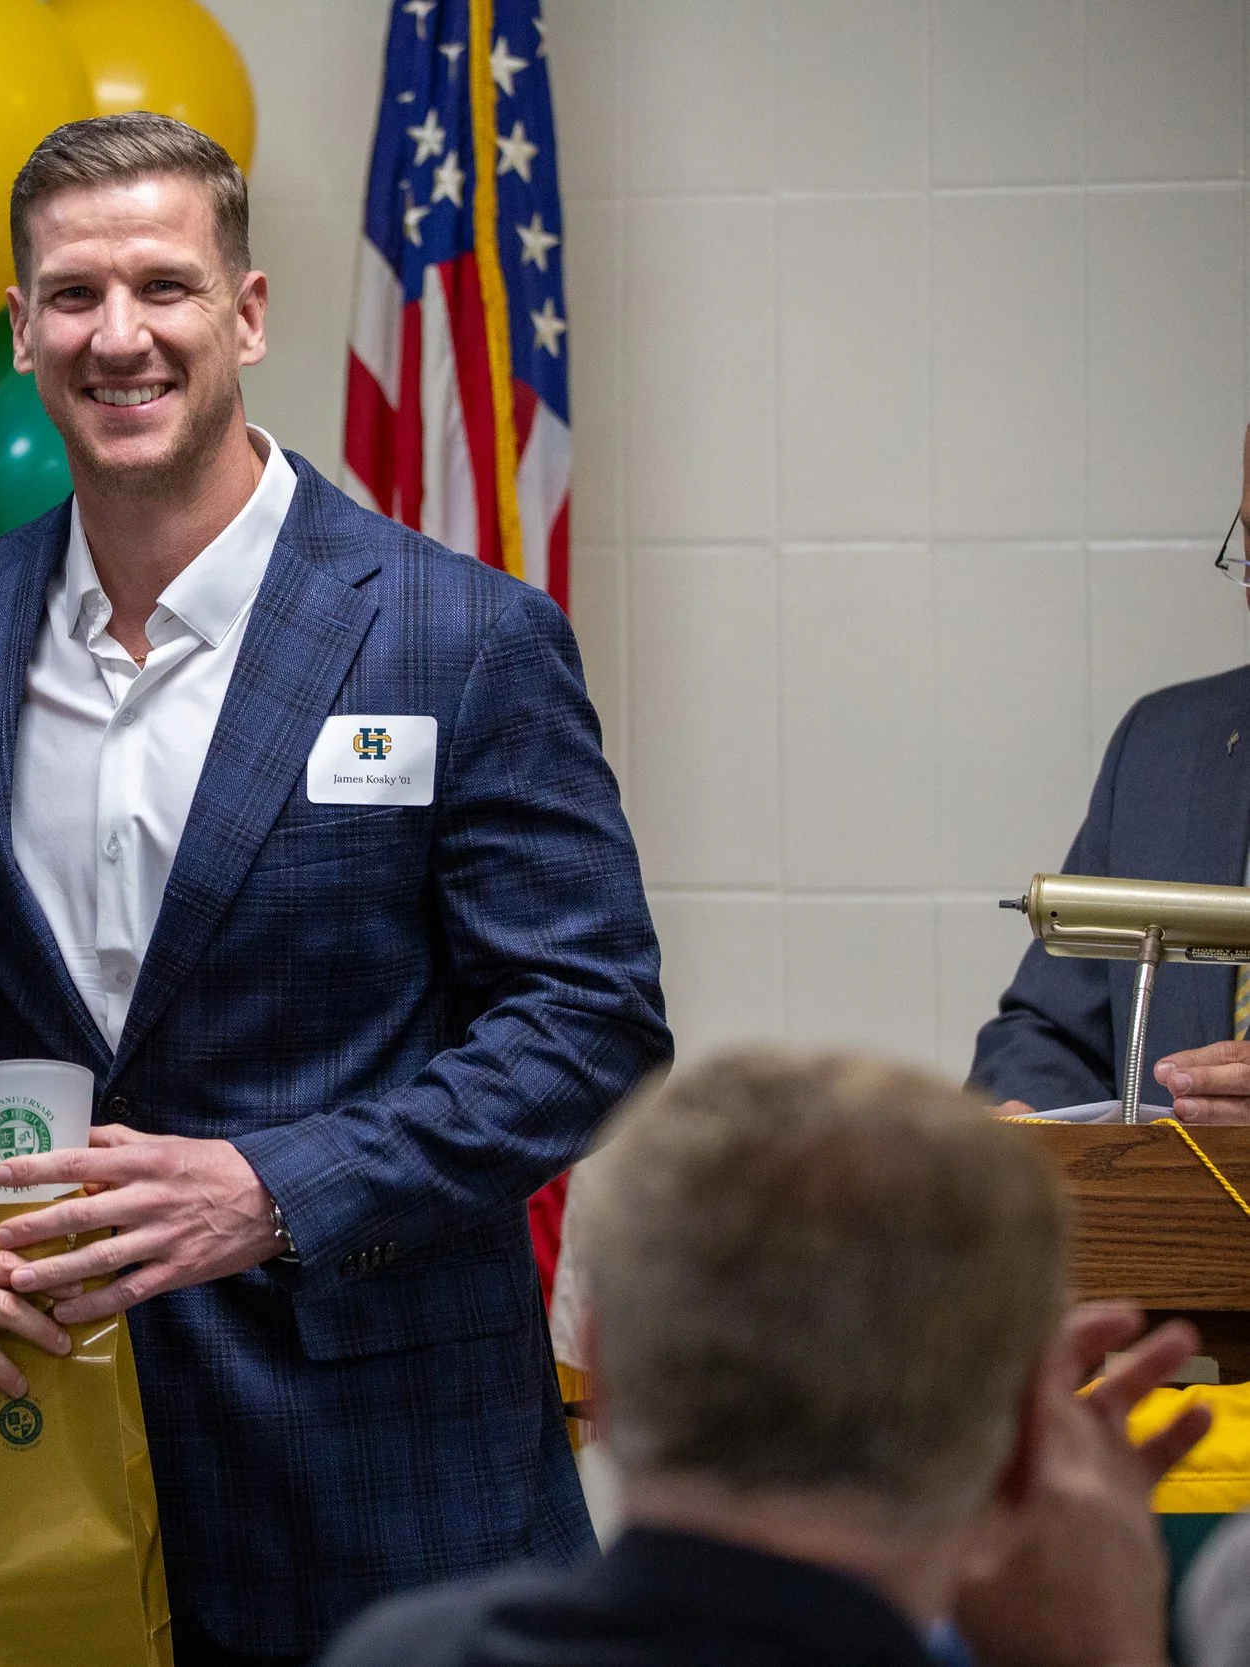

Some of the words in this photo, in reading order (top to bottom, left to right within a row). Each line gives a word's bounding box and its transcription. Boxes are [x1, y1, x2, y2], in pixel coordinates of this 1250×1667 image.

[333, 774, 363, 785] James
[366, 774, 397, 786] Kosky
[10, 1109, 39, 1125] HIGH
[38, 1124, 50, 1153] SCHO
